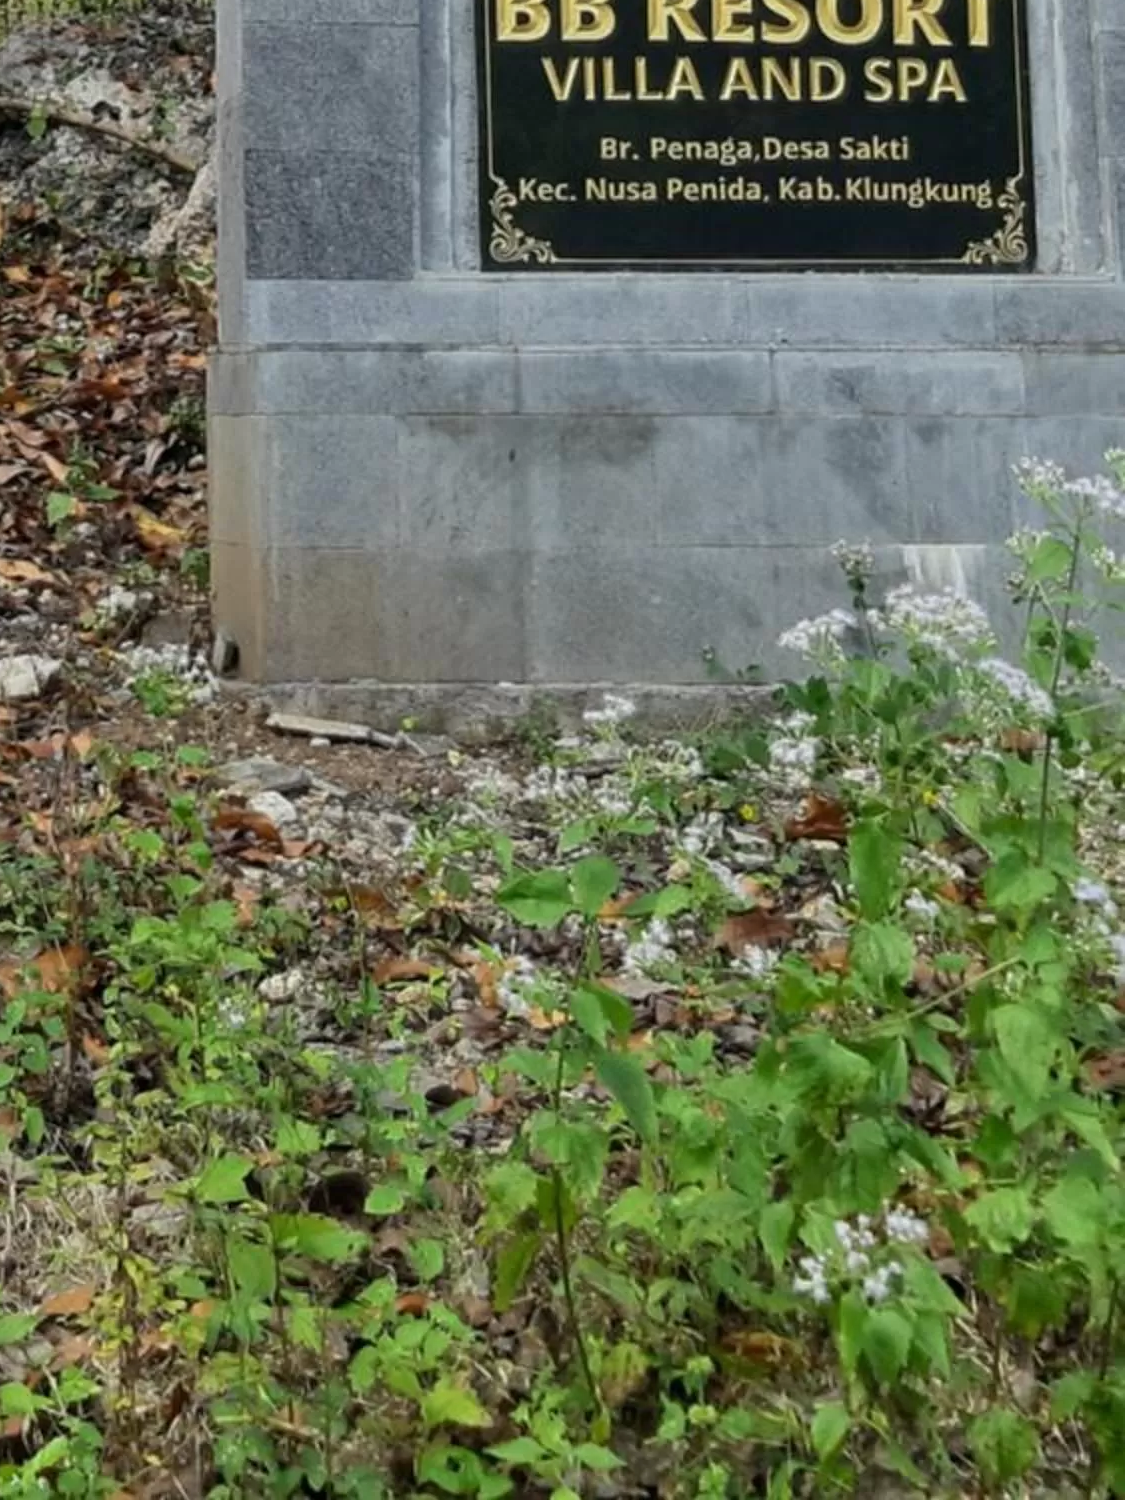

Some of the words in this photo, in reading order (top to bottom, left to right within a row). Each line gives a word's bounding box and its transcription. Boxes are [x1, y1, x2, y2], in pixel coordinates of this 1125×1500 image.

[541, 56, 705, 102] VILLA
[719, 57, 846, 102] AND
[864, 58, 968, 103] SPA
[600, 136, 640, 161] Br.
[839, 135, 910, 161] Sakti
[519, 177, 578, 202] Kec.
[585, 177, 658, 202] Nusa
